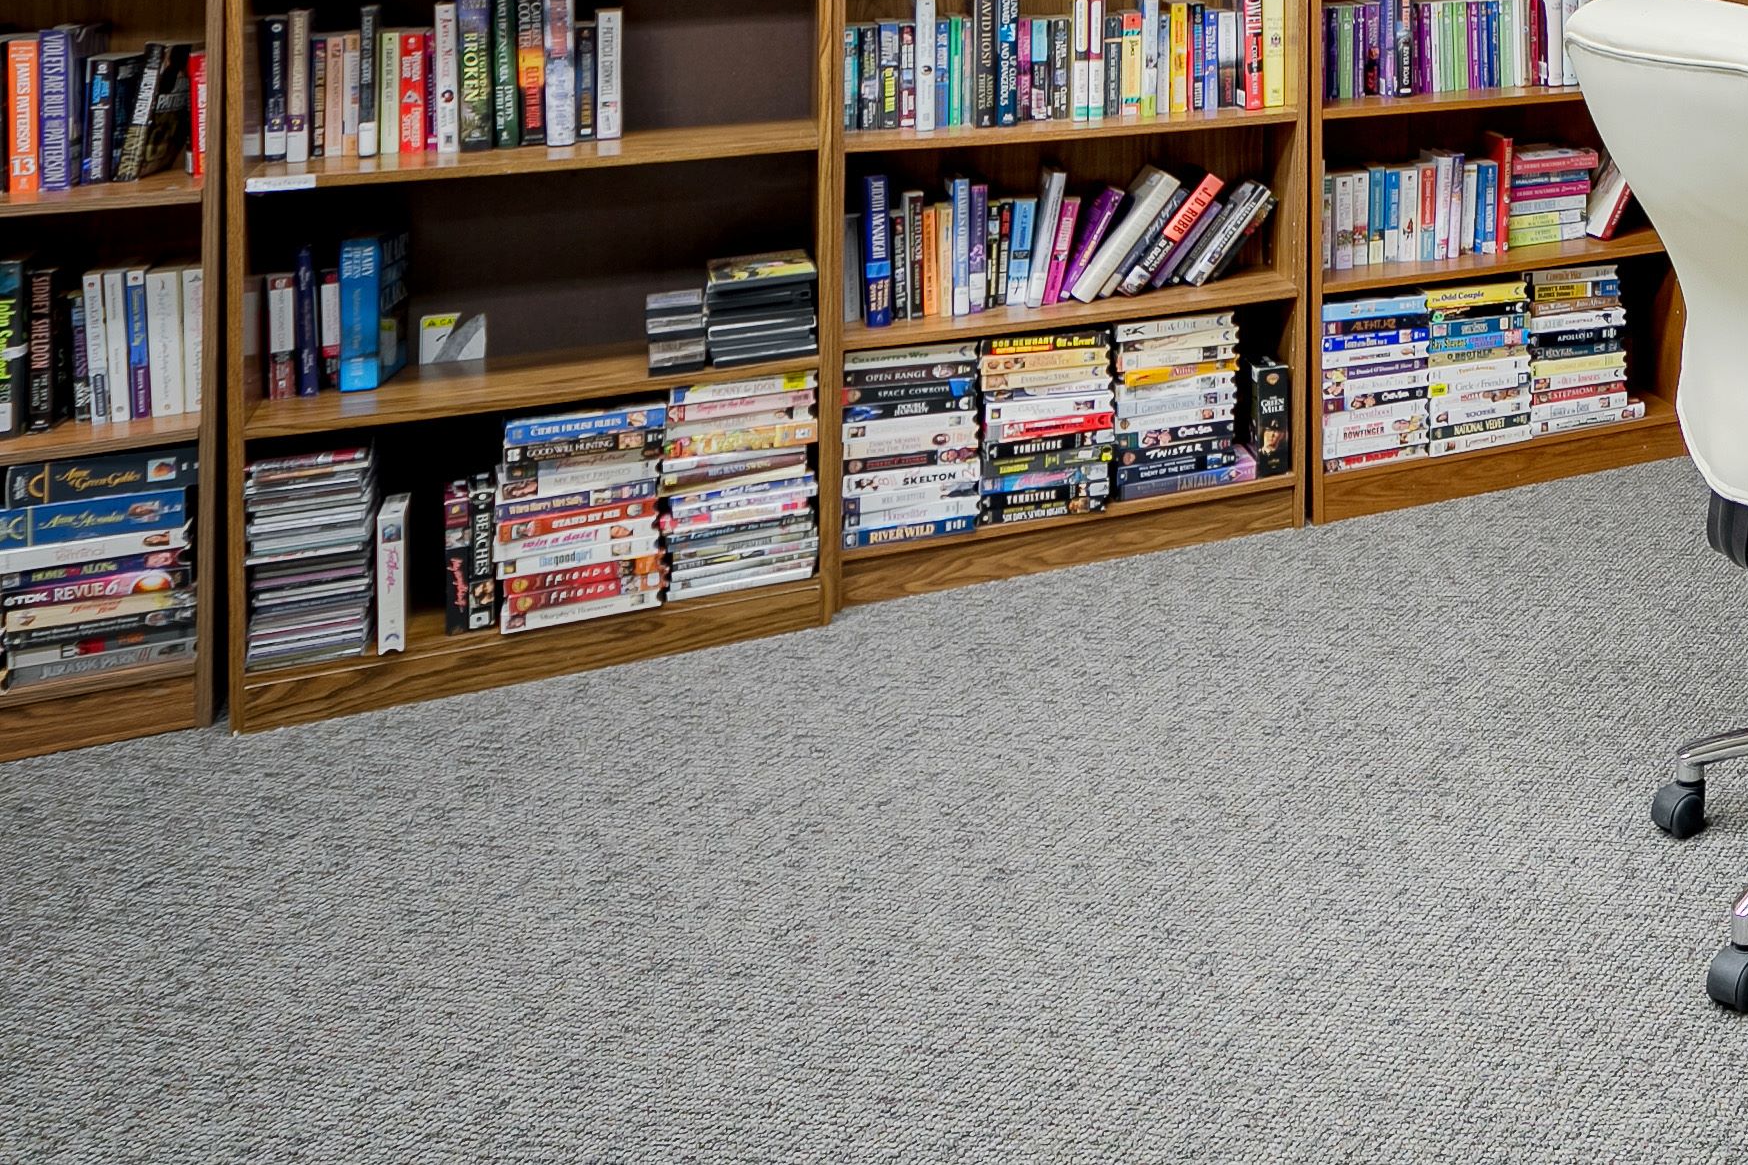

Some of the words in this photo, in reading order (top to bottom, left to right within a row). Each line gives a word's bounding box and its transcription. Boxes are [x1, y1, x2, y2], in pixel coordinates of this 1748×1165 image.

[42, 34, 65, 74] VIOLETS
[981, 33, 993, 68] HOSP
[16, 62, 30, 94] JAMES
[462, 33, 478, 104] BROKEN
[44, 74, 64, 93] ARE
[45, 94, 66, 118] BLUE
[16, 95, 31, 152] PATTERSON
[11, 155, 36, 177] 13
[1170, 209, 1197, 238] ROBB
[363, 246, 376, 277] MARY
[30, 275, 51, 314] SIDNEY
[29, 317, 52, 369] SHELDON
[865, 373, 893, 383] OPEN
[894, 370, 927, 381] RANGE
[1260, 397, 1285, 408] GREEN
[1551, 387, 1593, 400] STEPMOM
[1261, 405, 1285, 415] MILE
[1342, 426, 1385, 440] BOWFINGER
[1453, 422, 1483, 435] NATIONAL
[1484, 419, 1506, 432] VELVET
[1146, 443, 1204, 460] TWISTER
[902, 471, 958, 486] SKELTON
[474, 514, 489, 575] BEACHES
[868, 527, 905, 545] RIVER
[905, 522, 936, 539] WILD
[53, 586, 104, 602] REVUE
[104, 578, 118, 596] 6
[38, 658, 96, 680] JURASSIC
[97, 654, 136, 669] PARK
